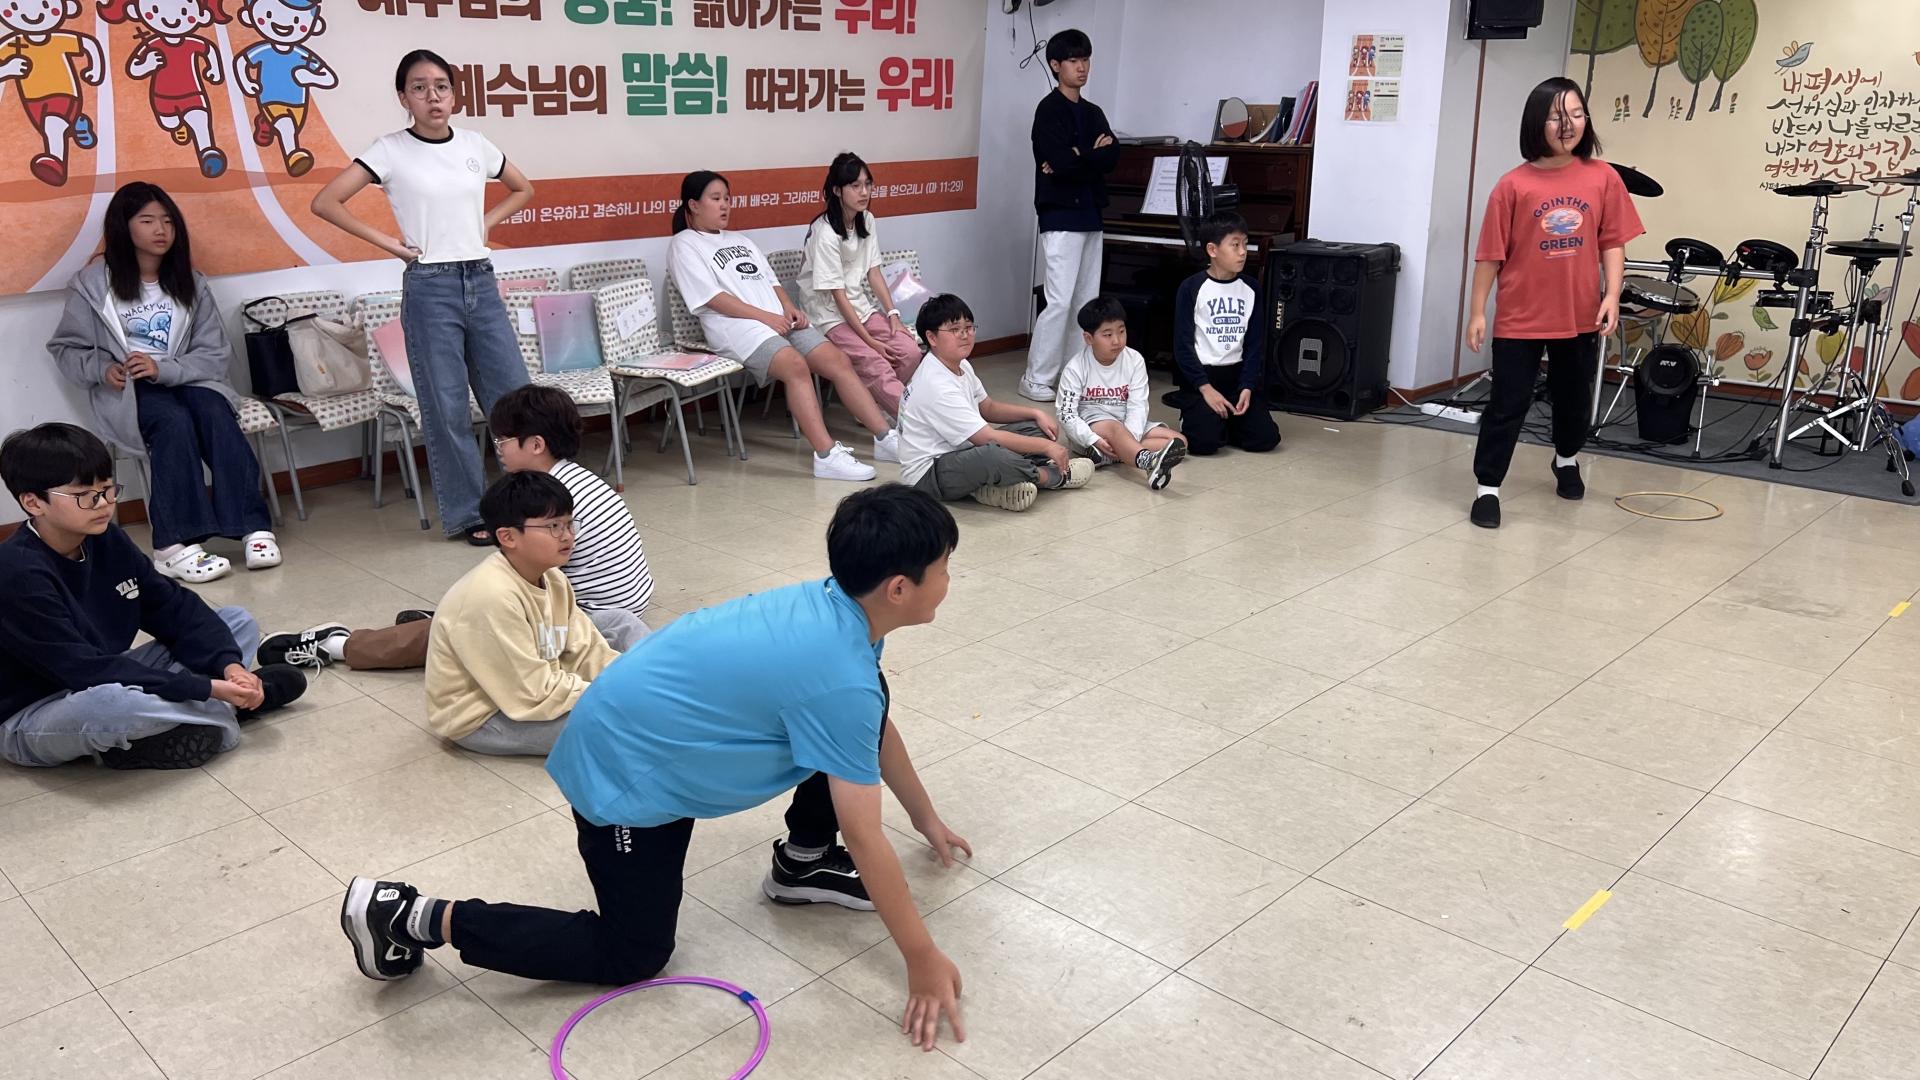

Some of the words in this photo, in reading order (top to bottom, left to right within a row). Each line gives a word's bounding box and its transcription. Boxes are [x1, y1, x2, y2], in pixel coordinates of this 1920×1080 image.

[449, 63, 607, 117] 예수님의
[622, 53, 728, 116] 말씀!
[745, 68, 865, 112] 따라가는
[877, 56, 954, 112] 우리!
[1772, 116, 1822, 138] 반드시
[1828, 117, 1871, 139] 나를
[1766, 138, 1807, 156] 내가
[540, 204, 590, 222] 온유하고
[593, 201, 640, 218] 겸손하니
[643, 200, 666, 214] 나의
[750, 193, 780, 207] 배우라
[783, 190, 820, 205] 그리하면
[890, 182, 924, 198] 얻으리니
[940, 180, 964, 194] 11:29)
[1567, 196, 1590, 212] THE
[1539, 236, 1584, 251] GREEN
[121, 303, 155, 319] WACKY
[1207, 297, 1246, 316] YALE
[381, 890, 397, 899] AIR
